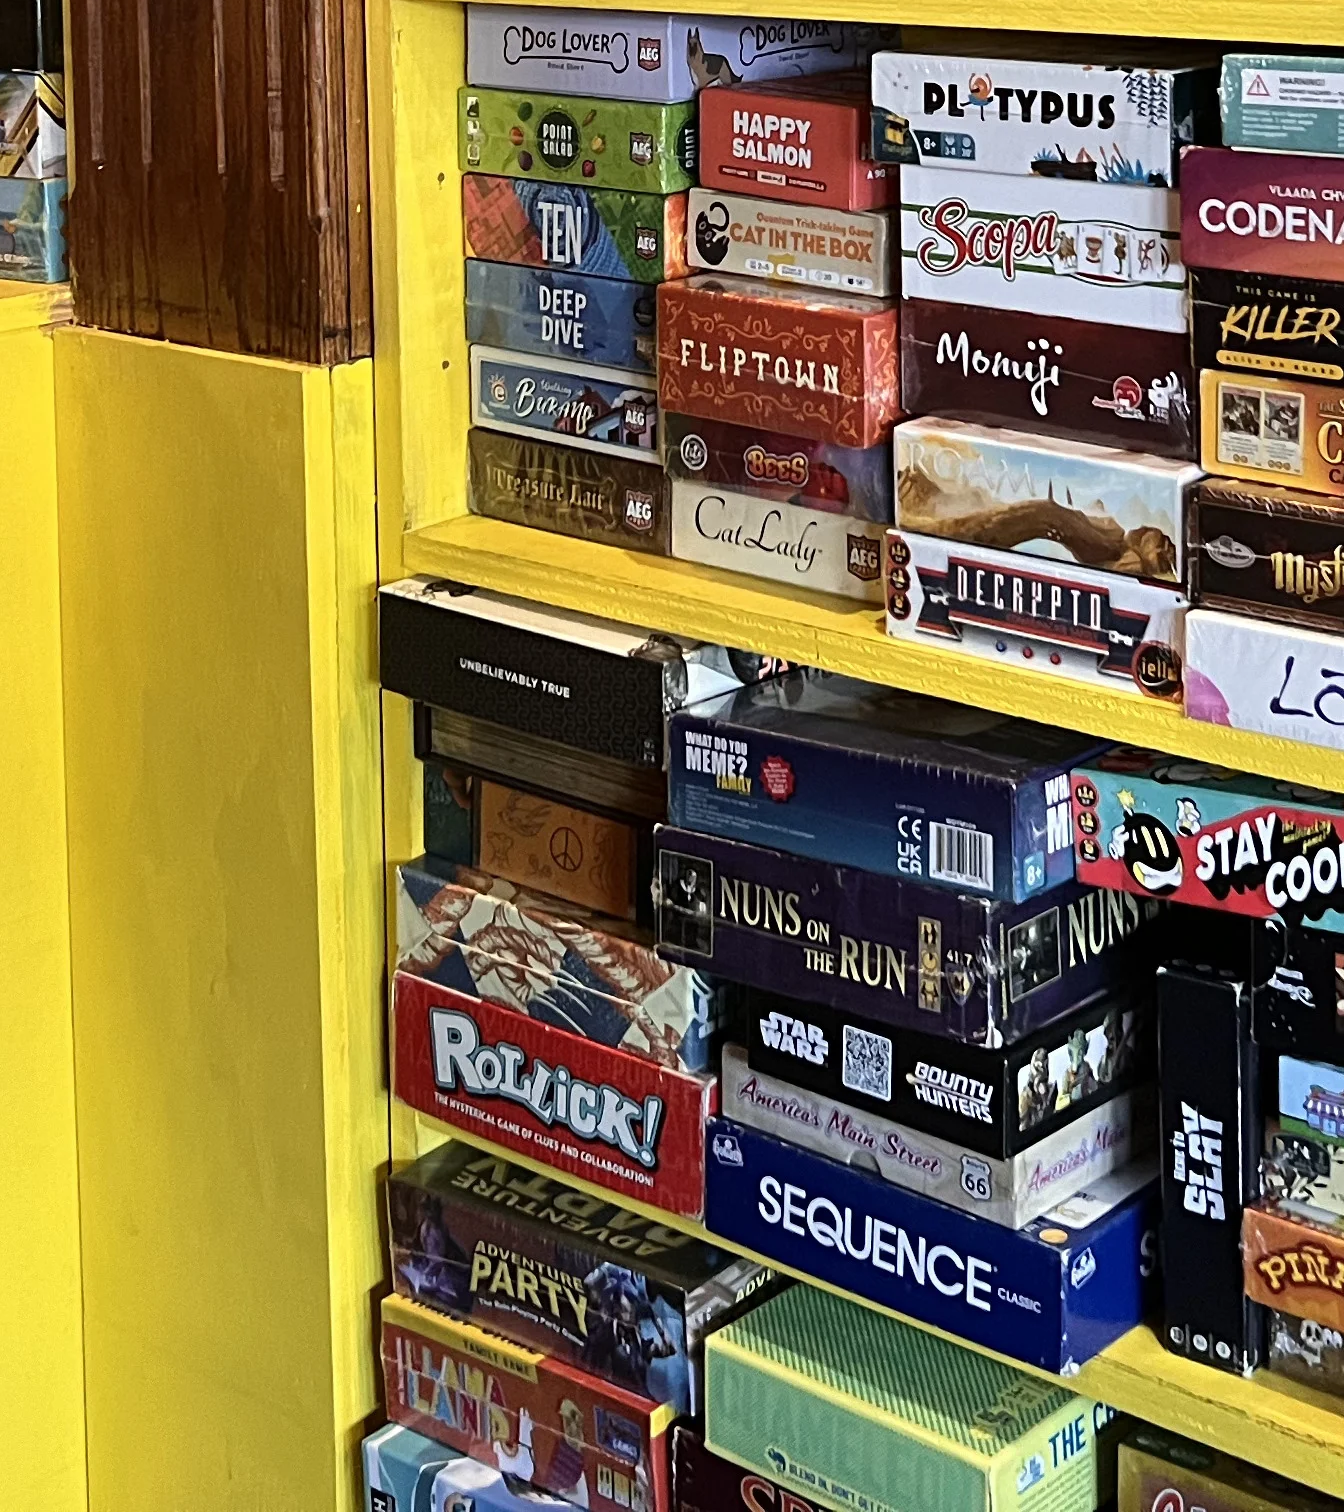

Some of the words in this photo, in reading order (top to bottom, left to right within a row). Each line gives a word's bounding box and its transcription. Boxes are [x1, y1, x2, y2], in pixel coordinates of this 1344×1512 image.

[520, 26, 557, 52] DOG
[561, 31, 612, 56] LOVER
[542, 123, 575, 142] POINT
[732, 110, 812, 145] HAPPY
[542, 140, 575, 159] SALAD
[732, 138, 813, 170] SALMON
[538, 200, 584, 266] TEN
[730, 221, 765, 247] CAT
[767, 228, 787, 249] IN
[790, 232, 826, 256] THE
[829, 237, 873, 265] BOX
[538, 285, 587, 320] DEEP
[542, 315, 585, 350] DIVE
[680, 337, 840, 396] FLIPTOWN
[957, 564, 1103, 631] DECRYPTO
[459, 656, 538, 690] UNBELIEVABLY
[540, 679, 571, 699] TRUE
[685, 730, 712, 748] WHAT
[714, 736, 727, 752] DO
[729, 739, 748, 756] YOU
[685, 745, 748, 779] MEME?
[1196, 811, 1279, 879] STAY
[719, 874, 803, 938] NUNS
[806, 918, 831, 944] ON
[803, 946, 835, 976] THE
[839, 932, 909, 998] RUN
[474, 1239, 585, 1289] ADVENTURE
[758, 1175, 994, 1313] SEQUENCE
[997, 1284, 1042, 1314] CLASSIC
[469, 1257, 590, 1337] PARTY
